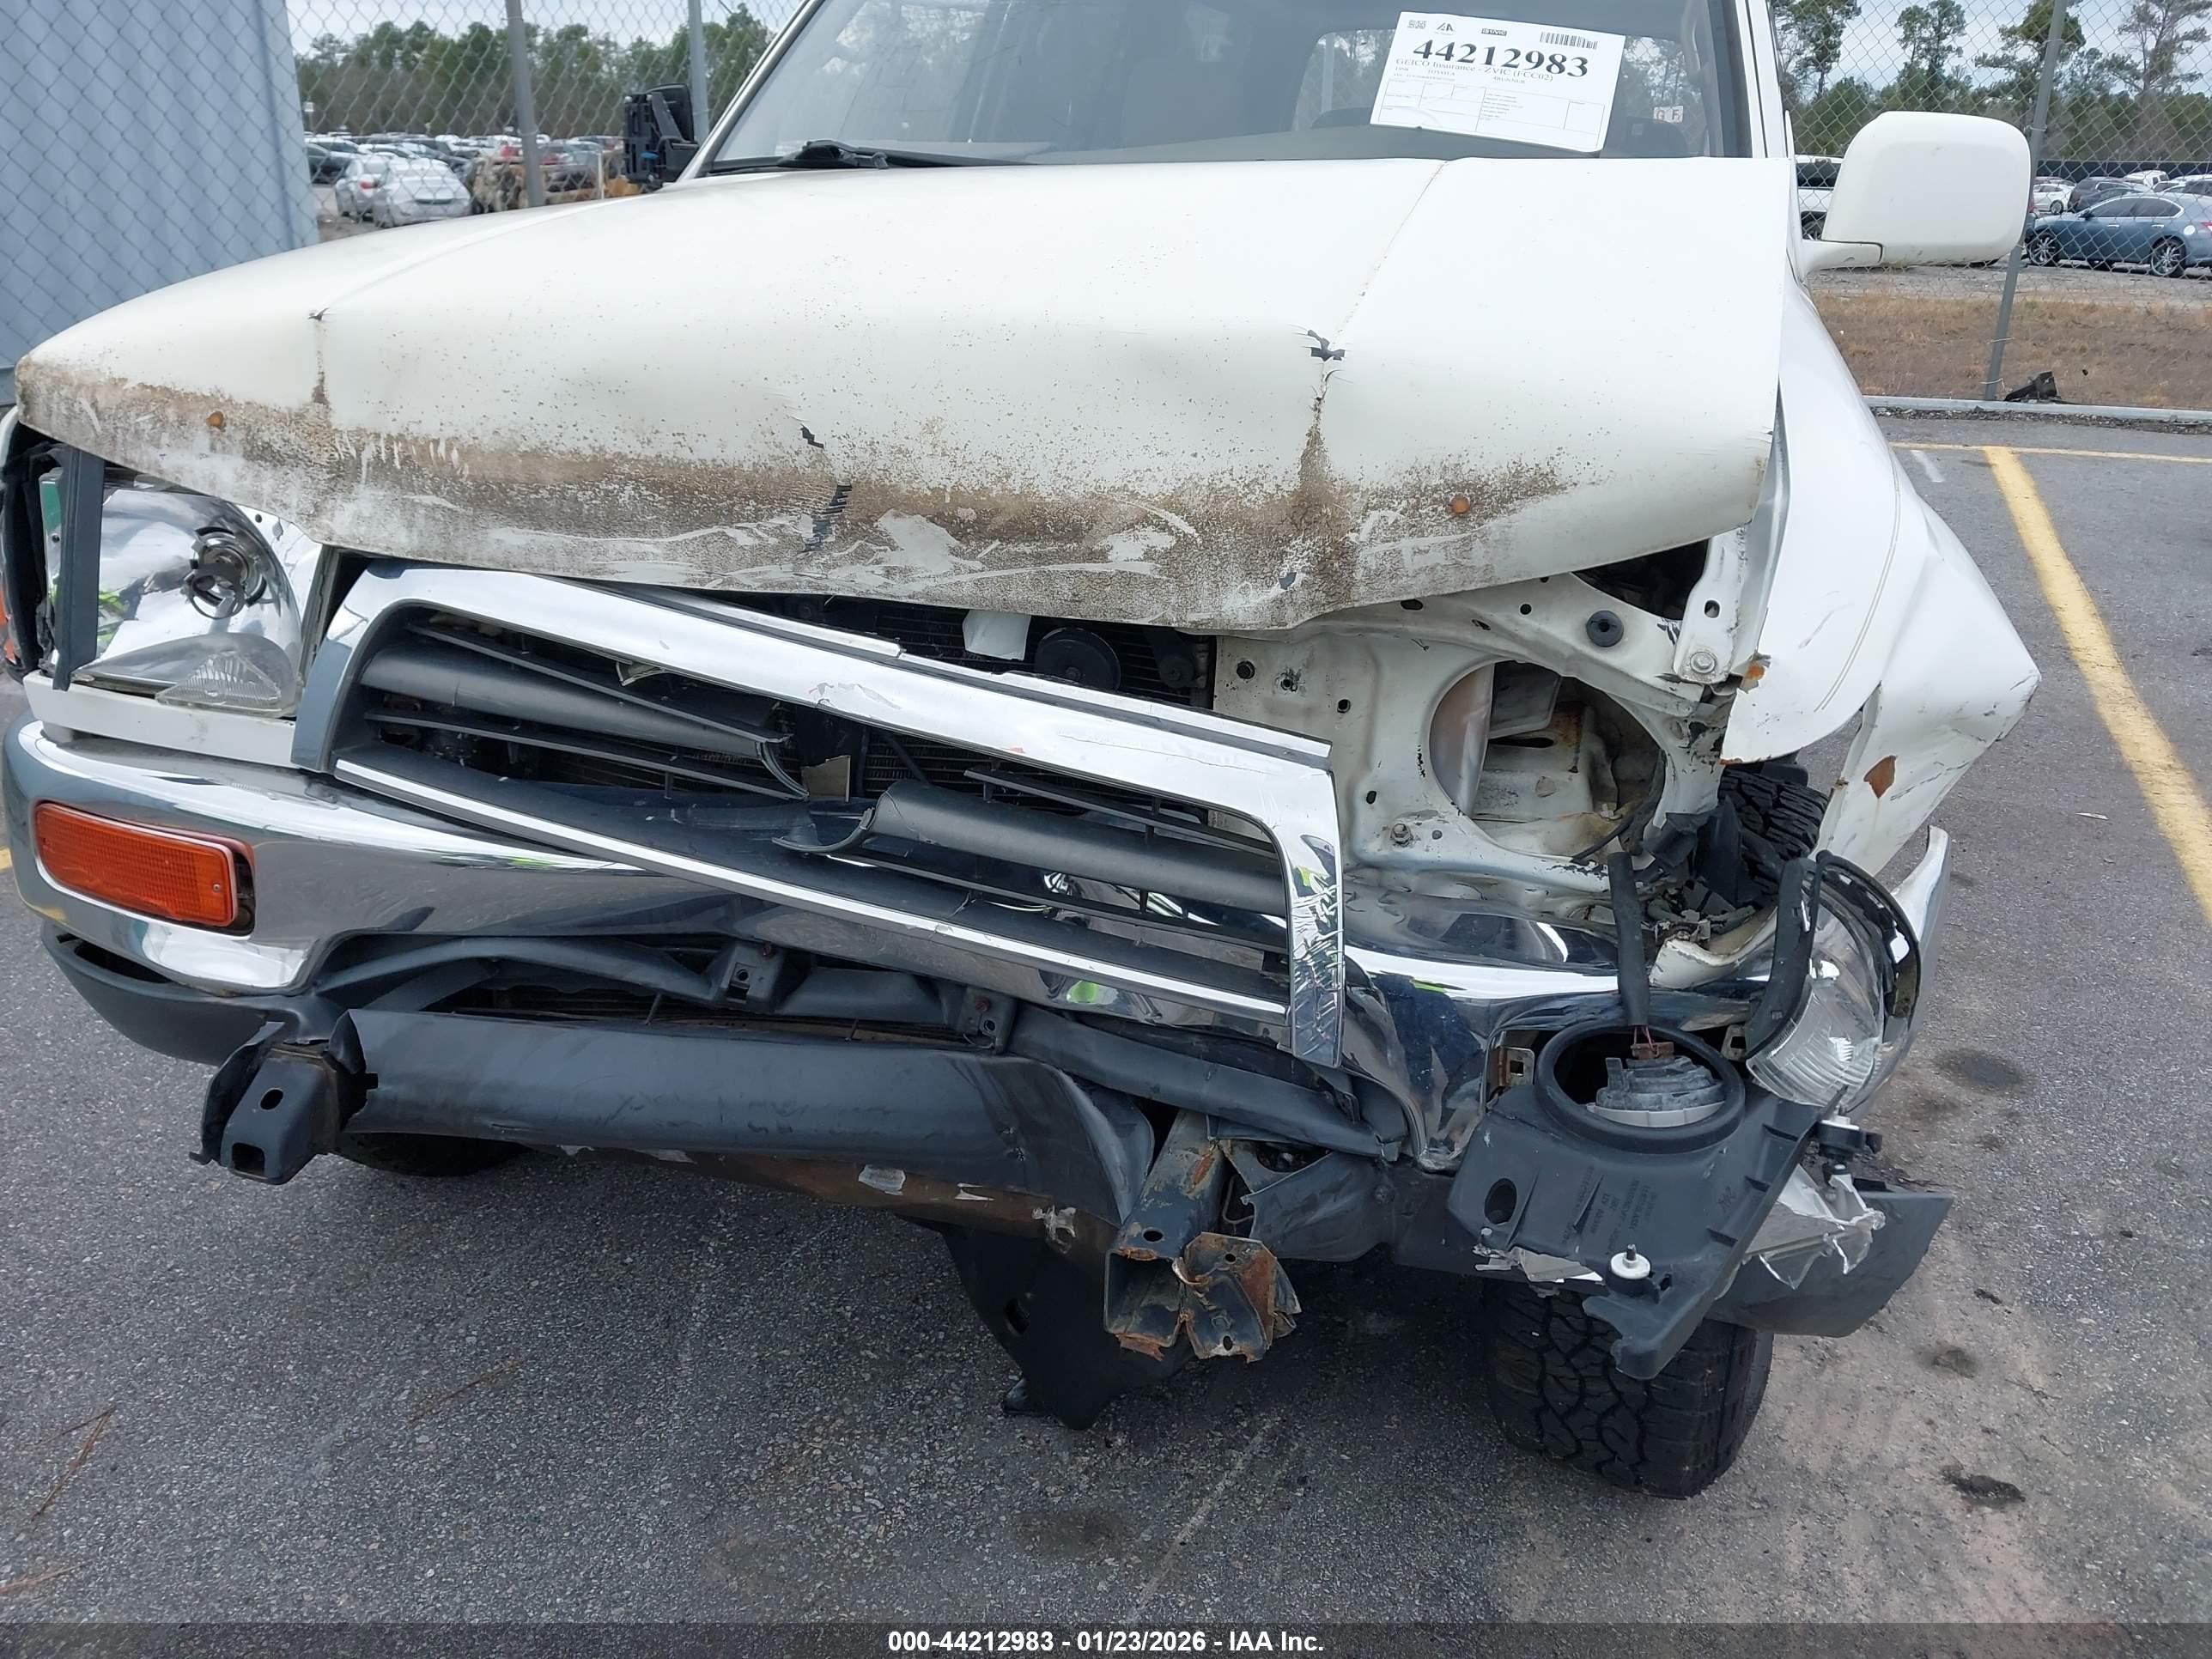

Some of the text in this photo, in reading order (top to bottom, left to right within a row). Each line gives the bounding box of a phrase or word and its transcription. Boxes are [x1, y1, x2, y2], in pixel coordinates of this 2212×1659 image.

[1395, 58, 1431, 68] GEICO
[1432, 61, 1476, 72] Insurance
[1484, 66, 1511, 76] ZVIC
[1513, 70, 1554, 82] (FCC02)
[1413, 39, 1589, 77] 44212983
